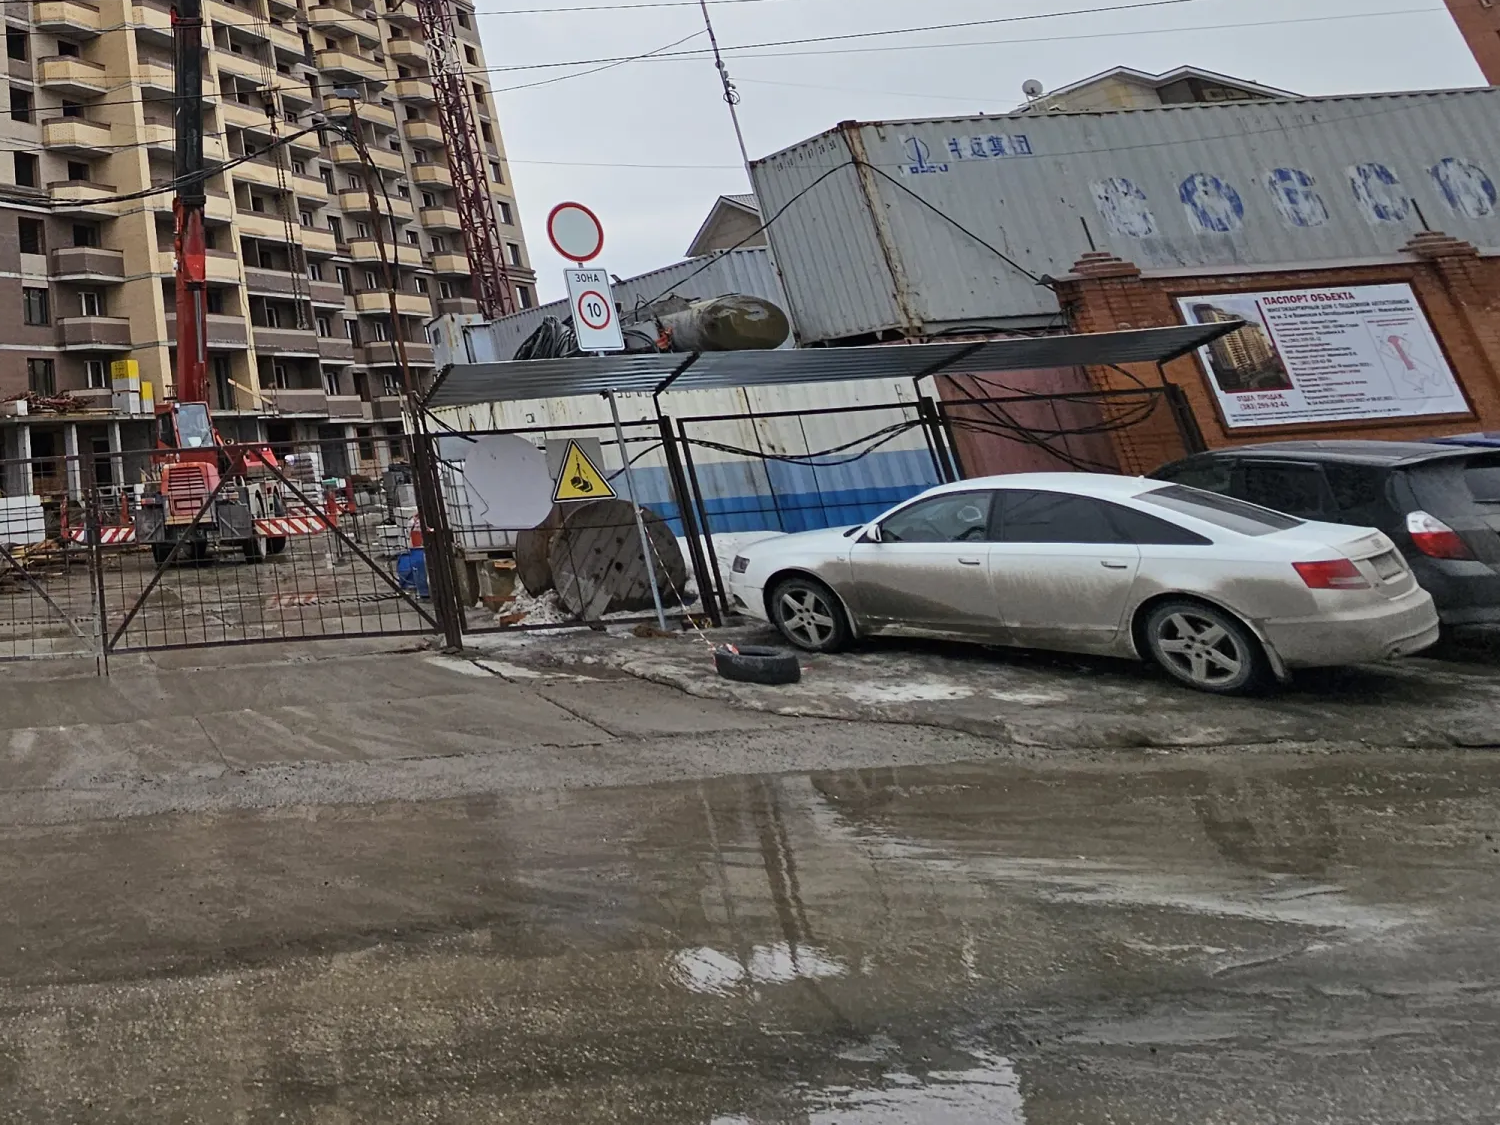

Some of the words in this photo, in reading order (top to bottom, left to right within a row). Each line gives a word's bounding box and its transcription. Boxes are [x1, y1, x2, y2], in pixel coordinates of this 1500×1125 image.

[575, 273, 600, 283] ЗОНА
[1262, 294, 1308, 305] ПАСПОРТ
[1310, 291, 1355, 302] ОБЪЕКТА
[587, 302, 602, 318] 10
